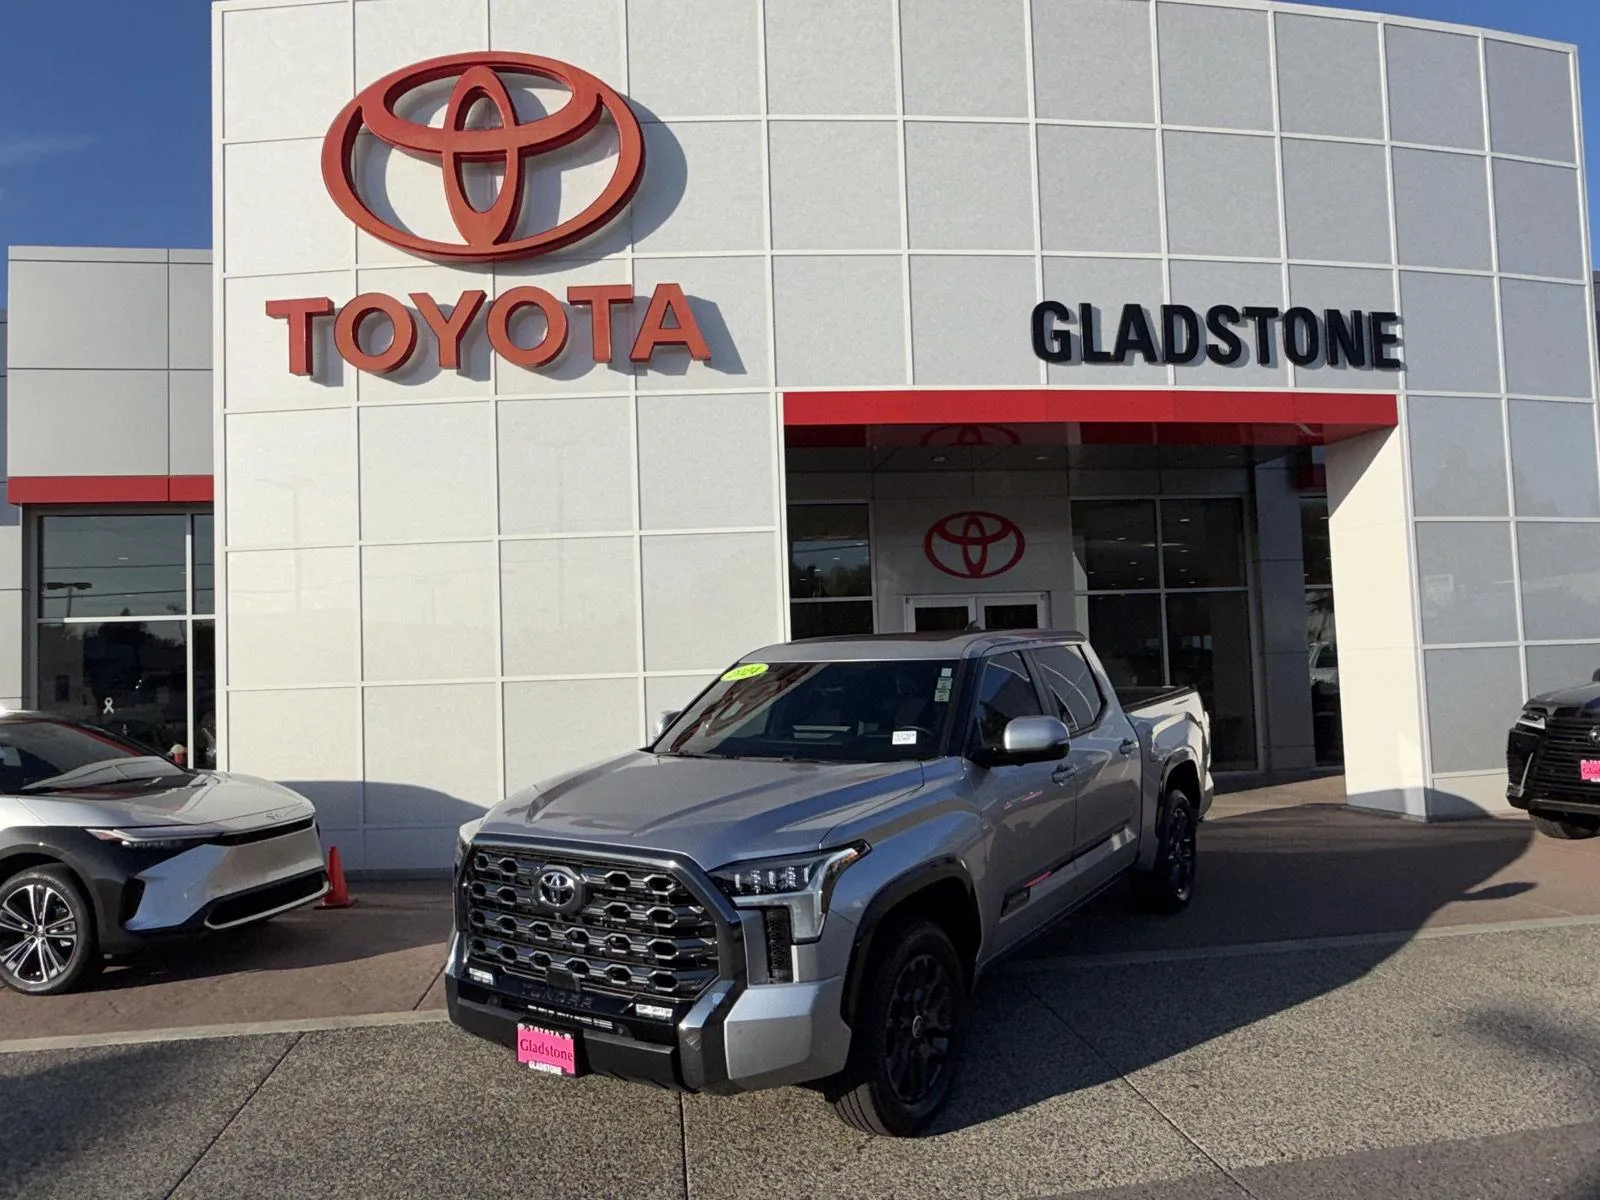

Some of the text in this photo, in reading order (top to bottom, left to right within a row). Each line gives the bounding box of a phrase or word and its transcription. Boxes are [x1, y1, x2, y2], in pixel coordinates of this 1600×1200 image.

[265, 283, 712, 377] TOYOTA
[1031, 301, 1404, 369] GLADSTONE
[519, 1039, 573, 1062] Gladstone
